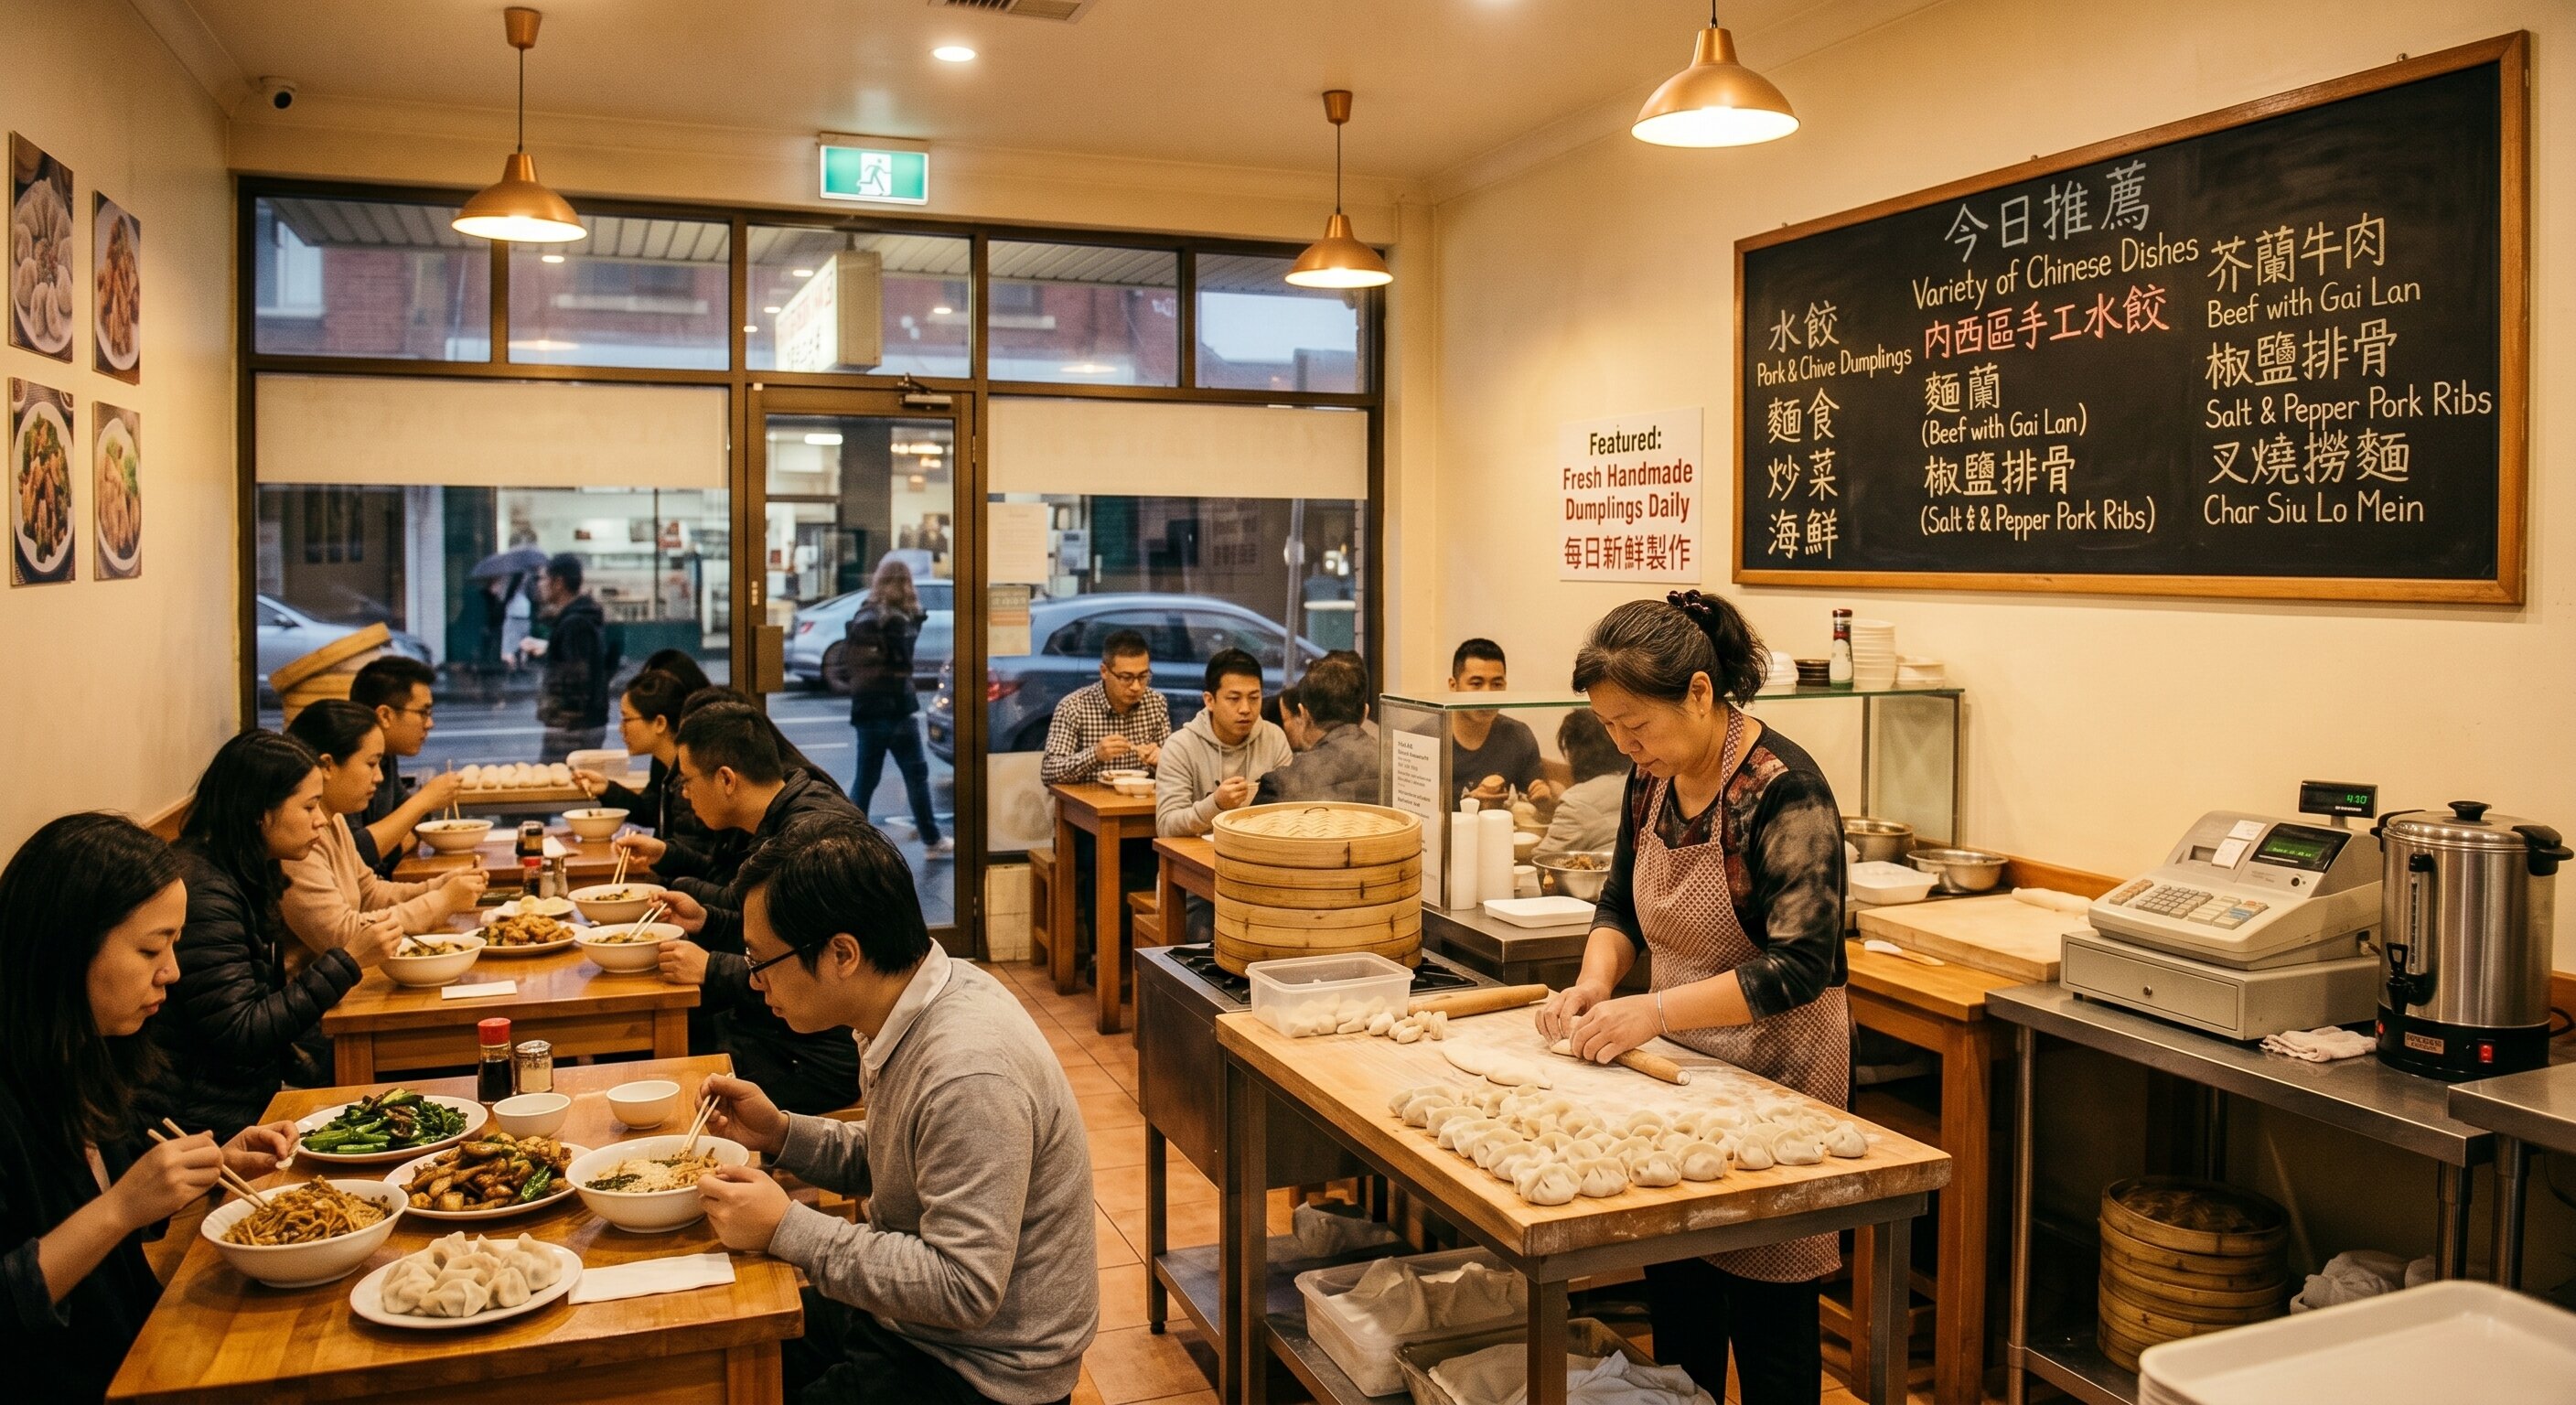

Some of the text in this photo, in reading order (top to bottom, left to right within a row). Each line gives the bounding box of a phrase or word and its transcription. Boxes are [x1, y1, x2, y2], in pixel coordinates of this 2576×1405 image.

[1944, 160, 2150, 263] 今日推薦
[1913, 232, 2199, 311] Variety of Chinese Dishes
[2206, 211, 2386, 293] 芥蘭牛肉
[1768, 300, 1840, 353] 水餃
[2207, 276, 2420, 328] Beef with Gai Lan
[1757, 344, 1913, 387] Pork & Chive Dumplings
[2205, 317, 2398, 390] 椒鹽排骨
[1925, 361, 2000, 415] 麵蘭
[2206, 380, 2492, 430] Salt & Pepper Pork Ribs
[1590, 425, 1662, 456] Featured:
[1767, 387, 1840, 445] 麵食
[1922, 402, 2088, 448] (Beef with Gai Lan)
[1563, 458, 1693, 490] Fresh Handmade
[1767, 447, 1839, 501] 炒菜
[1924, 445, 2076, 499] 椒鹽排骨
[2207, 428, 2410, 486] 叉燒撈麵
[1565, 491, 1690, 525] Dumplings Daily
[1921, 504, 1962, 536] (Salt
[1980, 505, 1991, 531] &
[1996, 503, 2050, 542] Pepper
[2057, 499, 2097, 531] Pork
[2104, 496, 2155, 533] Ribs)
[2204, 489, 2424, 525] Char Siu Lo Mein
[1564, 534, 1691, 571] 每日新鮮製作
[1767, 508, 1839, 559] 海鮮
